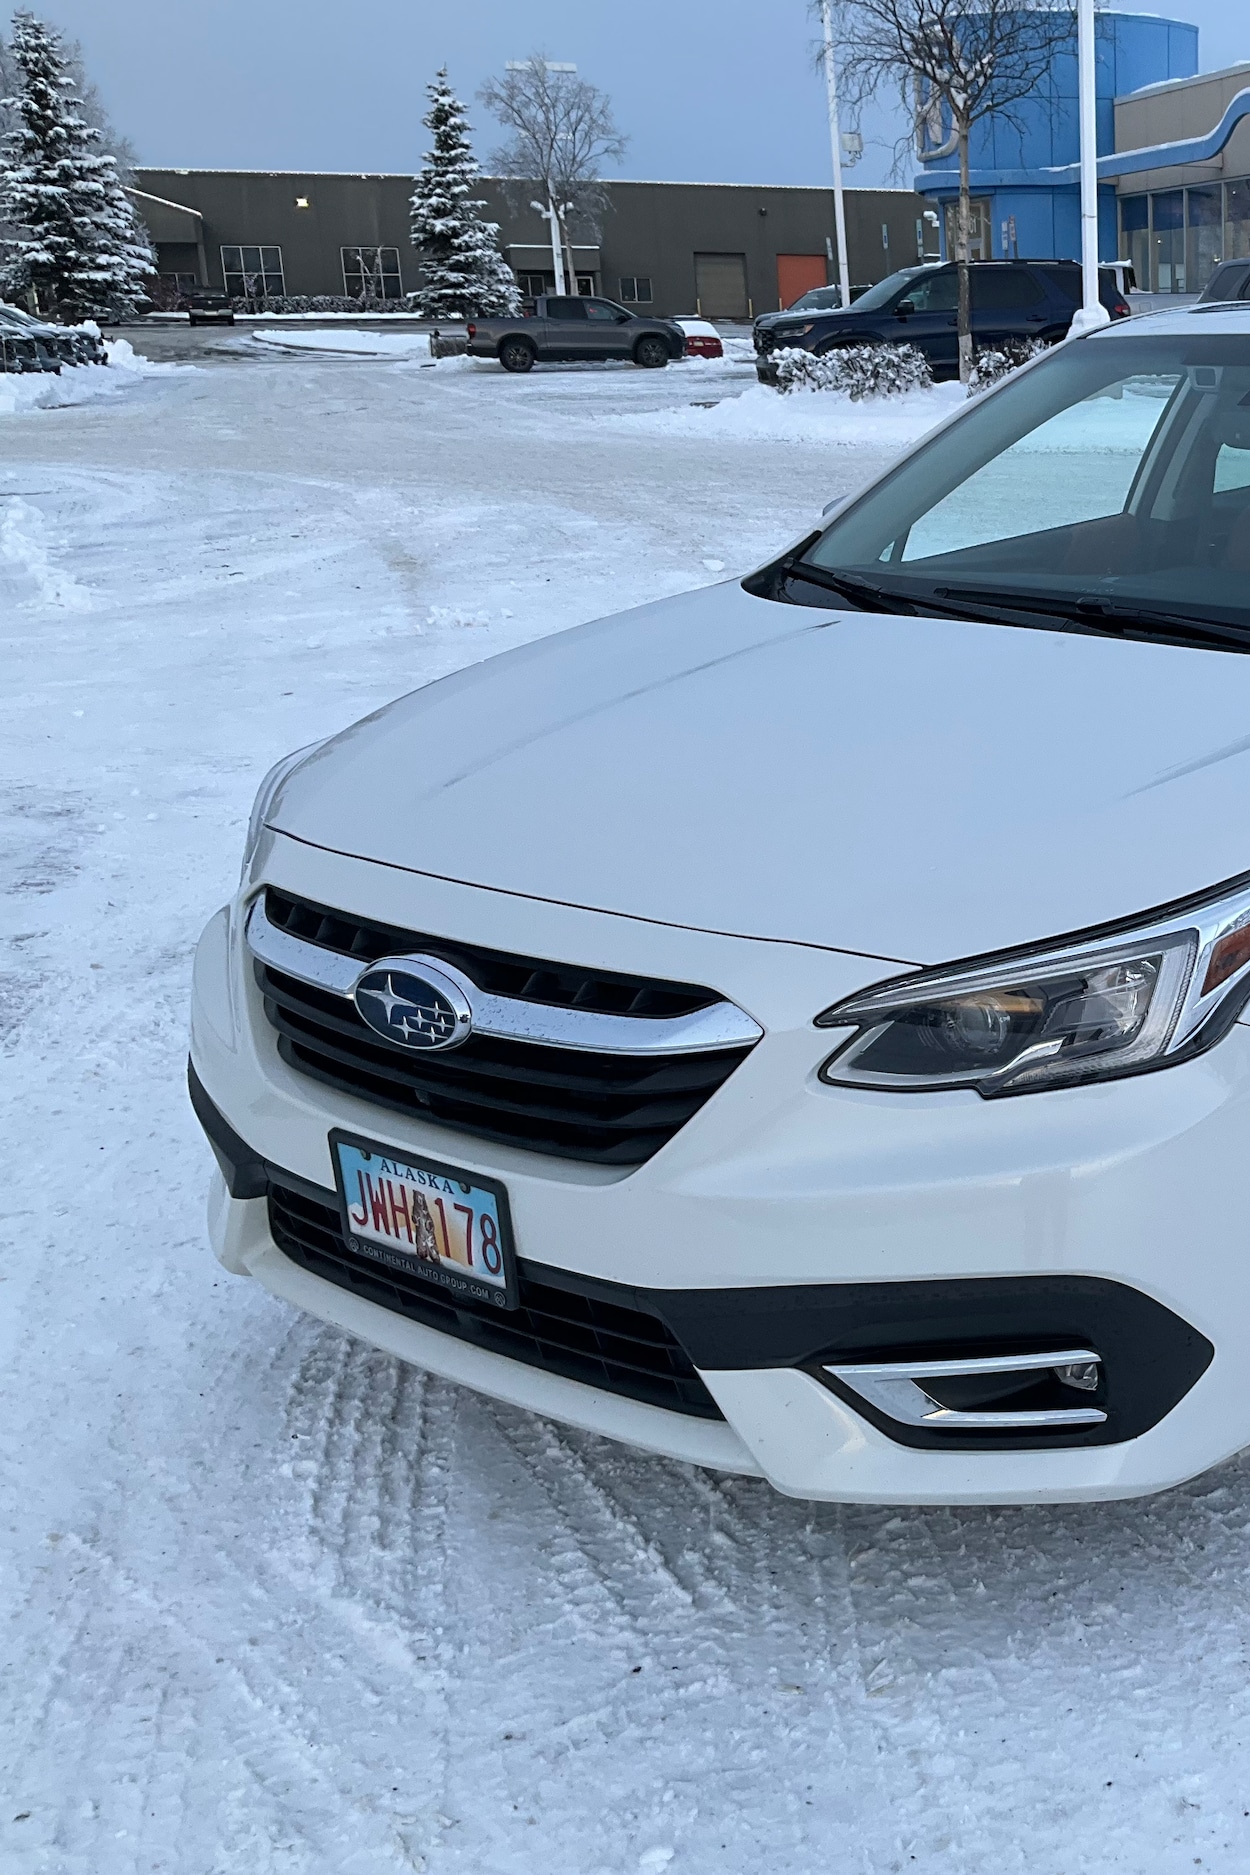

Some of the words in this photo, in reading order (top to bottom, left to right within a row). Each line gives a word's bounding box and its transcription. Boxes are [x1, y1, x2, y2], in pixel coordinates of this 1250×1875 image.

[380, 1159, 455, 1194] ALASKA
[351, 1169, 414, 1244] JWH
[434, 1197, 502, 1275] 178
[363, 1244, 416, 1273] CONTINENTAL
[417, 1265, 439, 1281] AUTO
[440, 1273, 468, 1291] GROUP
